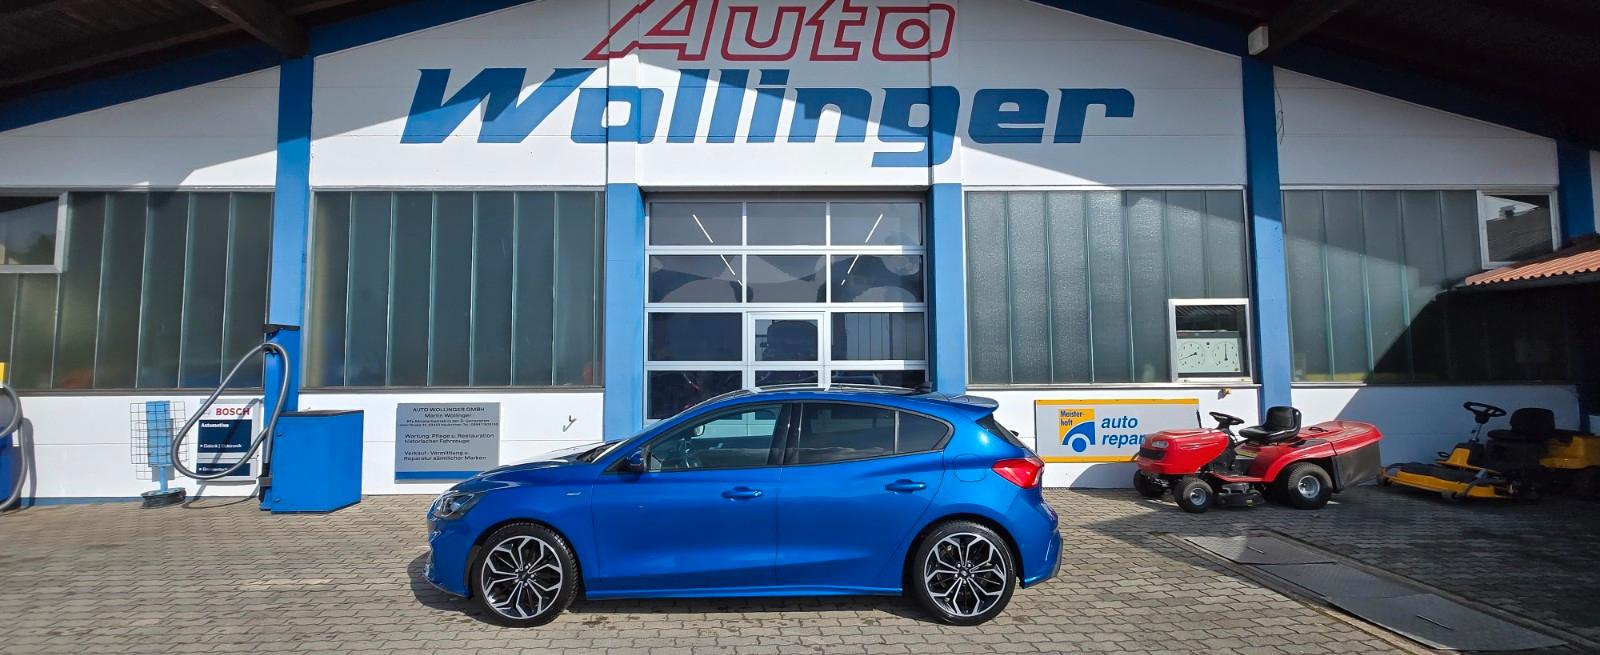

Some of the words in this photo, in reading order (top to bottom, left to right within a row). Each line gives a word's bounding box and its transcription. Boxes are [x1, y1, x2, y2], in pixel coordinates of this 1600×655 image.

[582, 0, 956, 62] Auto
[400, 68, 1135, 167] Wollinger
[216, 407, 250, 415] BOSCH
[1101, 415, 1138, 429] auto
